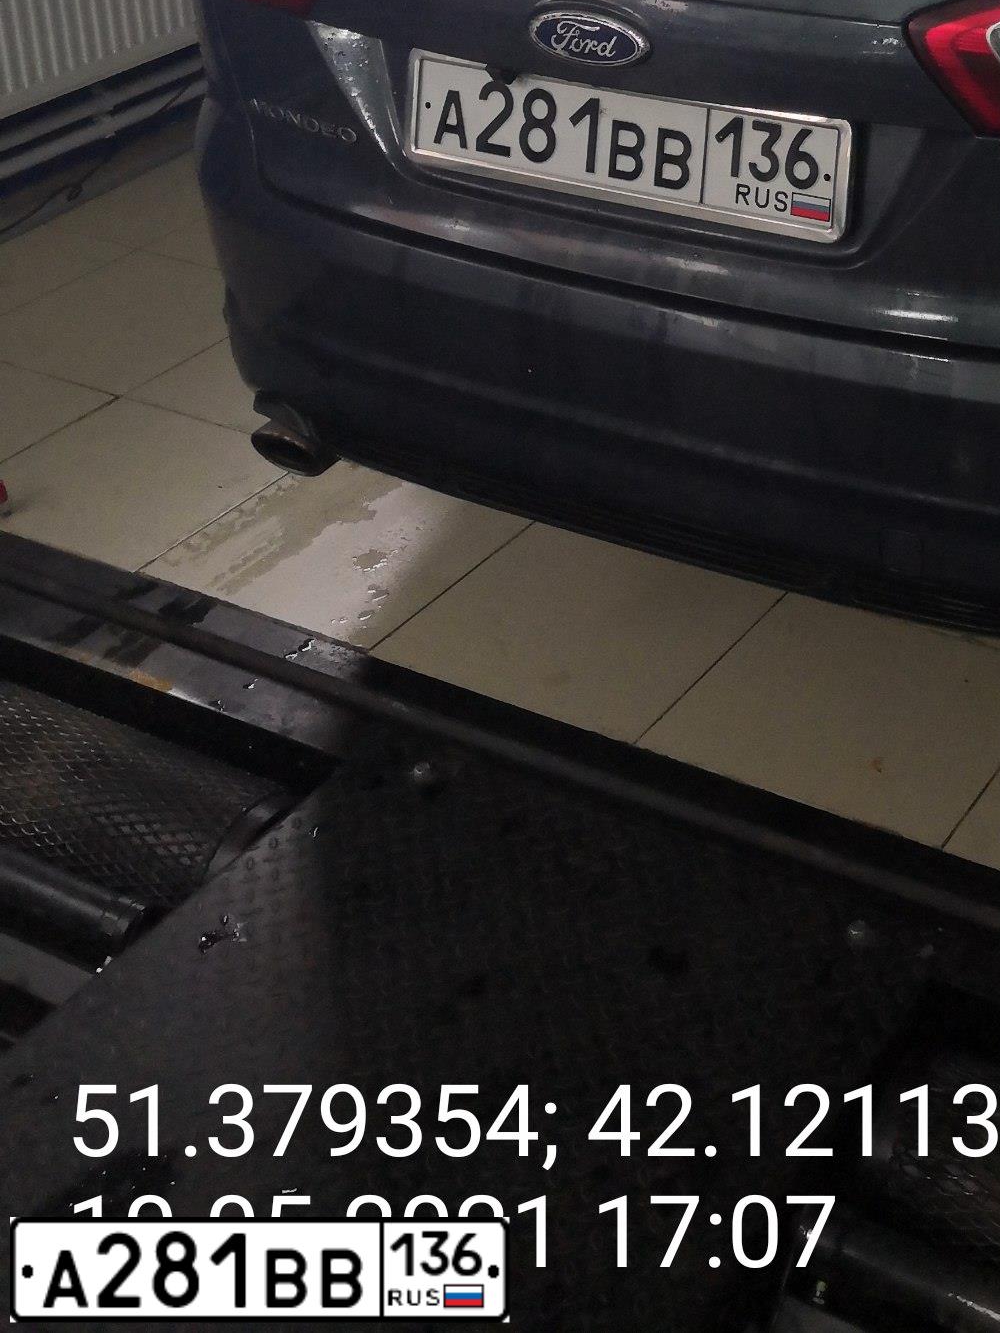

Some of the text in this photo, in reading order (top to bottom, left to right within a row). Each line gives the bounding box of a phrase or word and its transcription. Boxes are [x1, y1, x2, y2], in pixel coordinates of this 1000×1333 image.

[550, 20, 618, 58] Ford
[714, 116, 820, 190] 136
[735, 183, 789, 213] RUS
